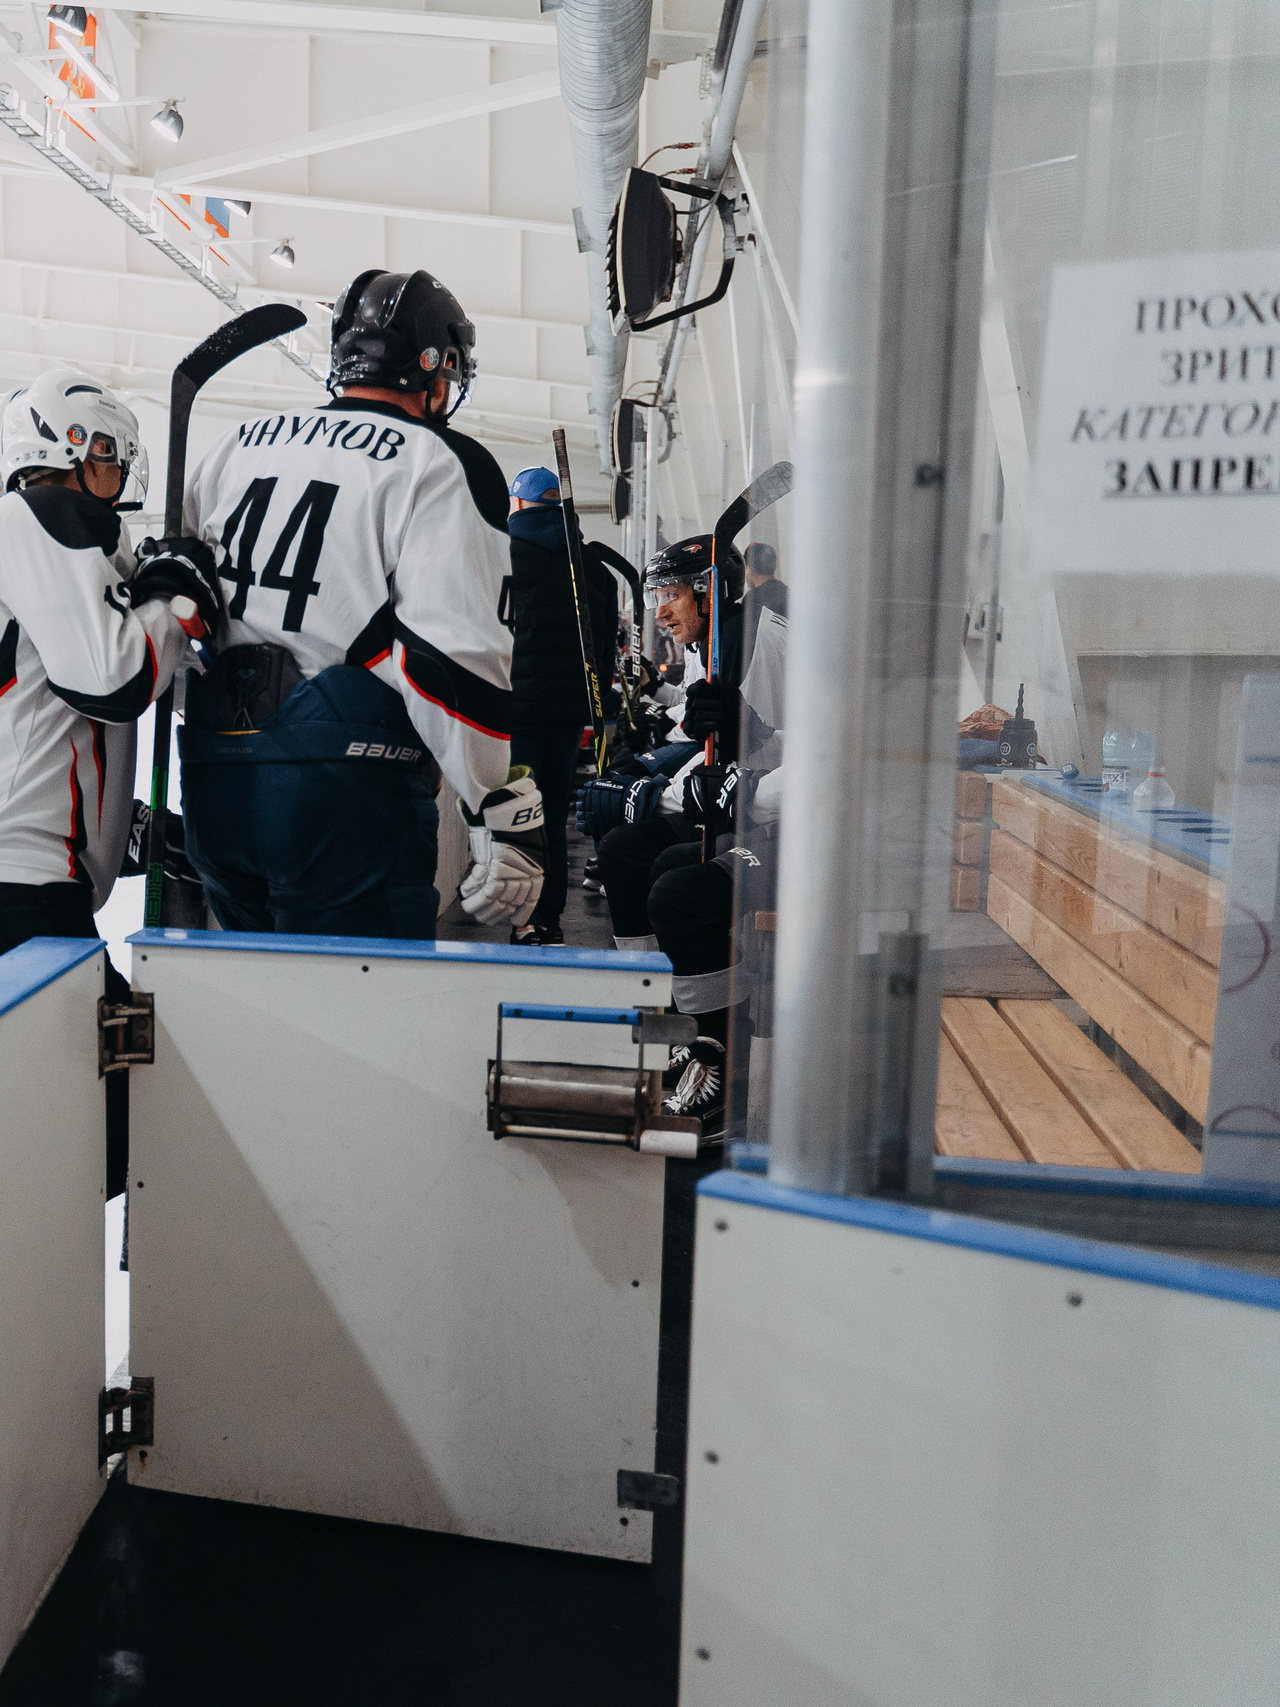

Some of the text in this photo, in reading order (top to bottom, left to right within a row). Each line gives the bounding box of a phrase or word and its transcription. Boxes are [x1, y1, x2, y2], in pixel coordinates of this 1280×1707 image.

[1135, 289, 1280, 333] ПРОХ
[1103, 454, 1280, 494] ЗАПРЕ
[217, 476, 341, 633] 44
[631, 624, 641, 677] BAUER
[590, 672, 603, 718] SUPER
[345, 742, 421, 763] BAUER
[511, 801, 544, 827] BA
[624, 778, 651, 824] CHE
[128, 802, 150, 864] EAS
